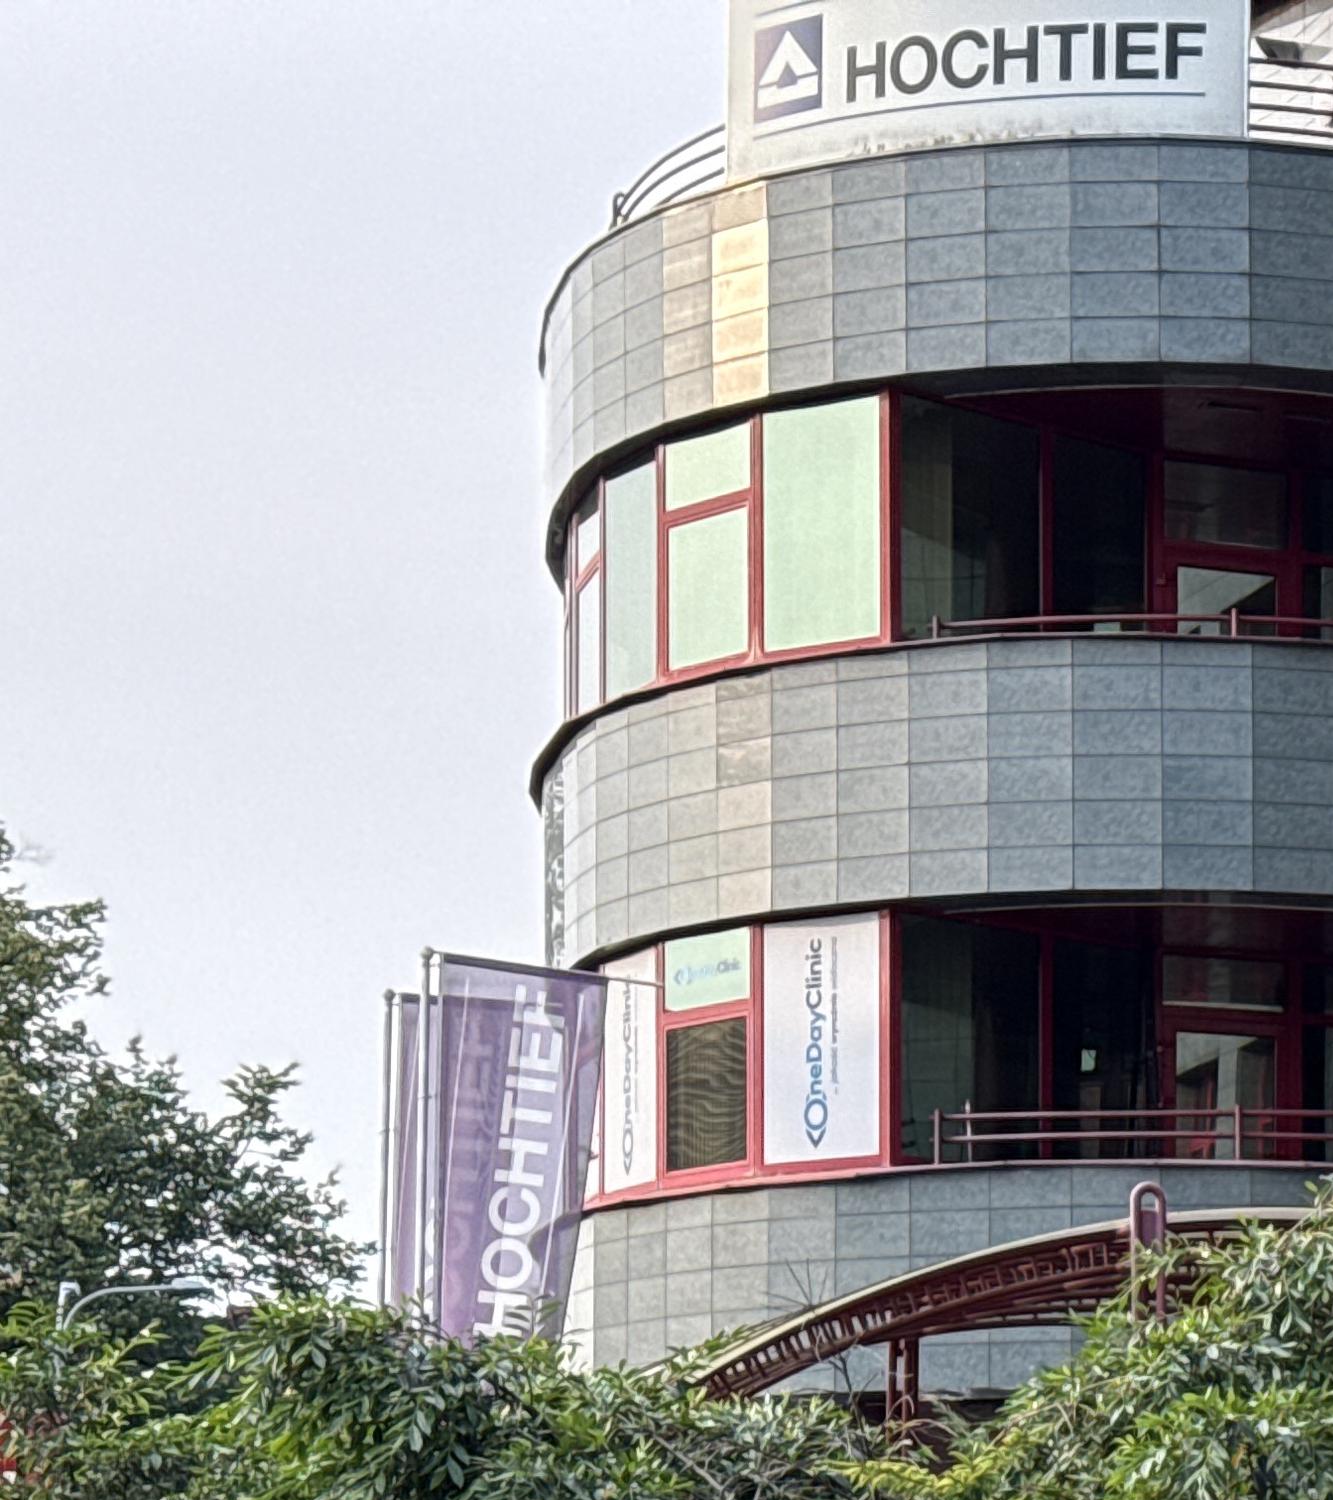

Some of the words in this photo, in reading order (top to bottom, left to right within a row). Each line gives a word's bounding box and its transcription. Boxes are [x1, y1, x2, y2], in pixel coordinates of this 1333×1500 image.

[846, 22, 1206, 103] HOCHTIEF
[803, 937, 829, 1134] OneDayClinic
[472, 983, 565, 1337] HOCHTIEF
